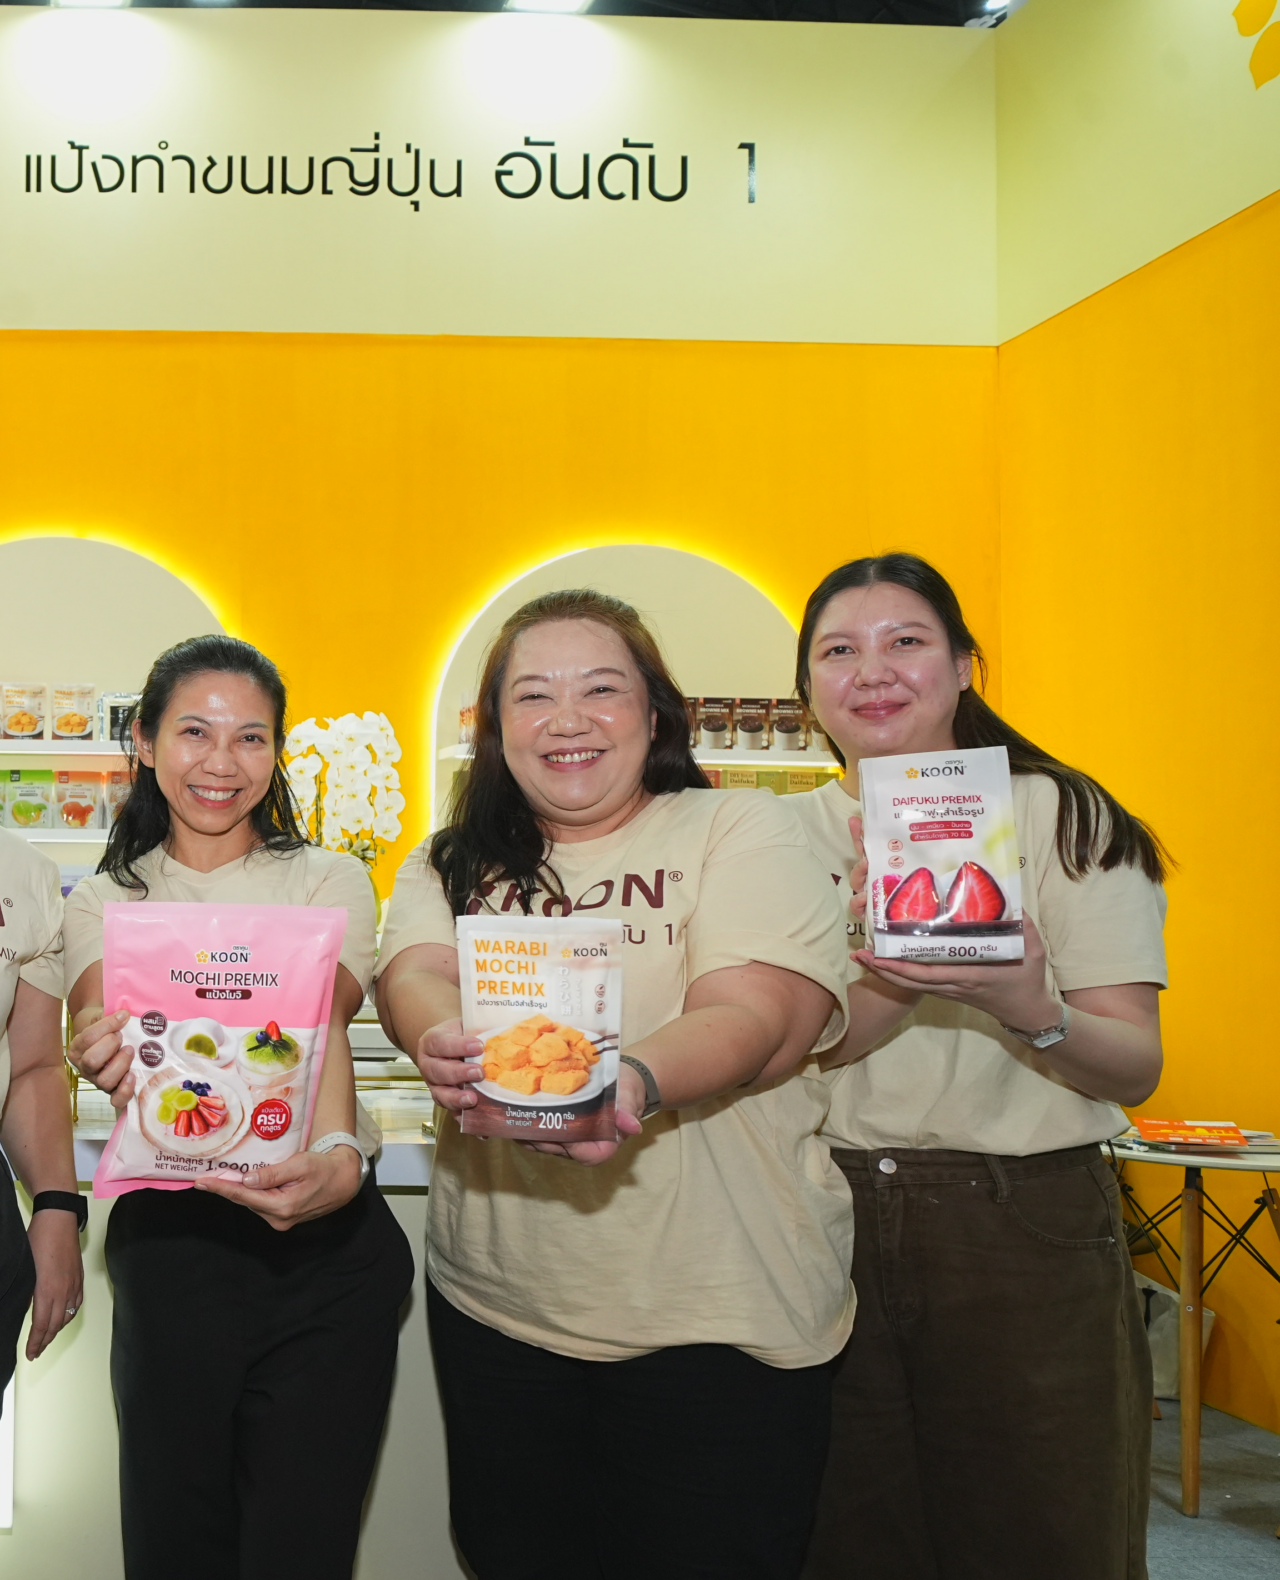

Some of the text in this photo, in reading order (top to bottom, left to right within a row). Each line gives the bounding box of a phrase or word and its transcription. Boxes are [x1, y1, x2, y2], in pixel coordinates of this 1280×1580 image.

[24, 132, 757, 212] แป้งทำขนมญี่ปุ่น อันดับ 1
[921, 765, 965, 778] KOON
[892, 794, 983, 807] DAIFUKU PREMIX
[664, 923, 673, 946] 1
[475, 939, 548, 956] WARABI
[573, 947, 608, 957] KOON
[947, 946, 977, 957] 800
[979, 944, 998, 952] กรัม
[211, 951, 249, 963] KOON
[475, 959, 537, 976] MOCHI
[170, 969, 279, 987] MOCHI PREMIX
[206, 989, 242, 1000] แป้งโมจิ
[477, 980, 546, 997] PREMIX
[256, 1113, 286, 1126] ครบ
[506, 1119, 515, 1127] NET
[538, 1111, 563, 1130] 200
[563, 1112, 575, 1120] กรัม
[260, 1125, 282, 1133] ทุกสูตร
[155, 1151, 249, 1174] น้ำหนักสุทธิ 1,000
[155, 1162, 198, 1173] NET WEIGHT
